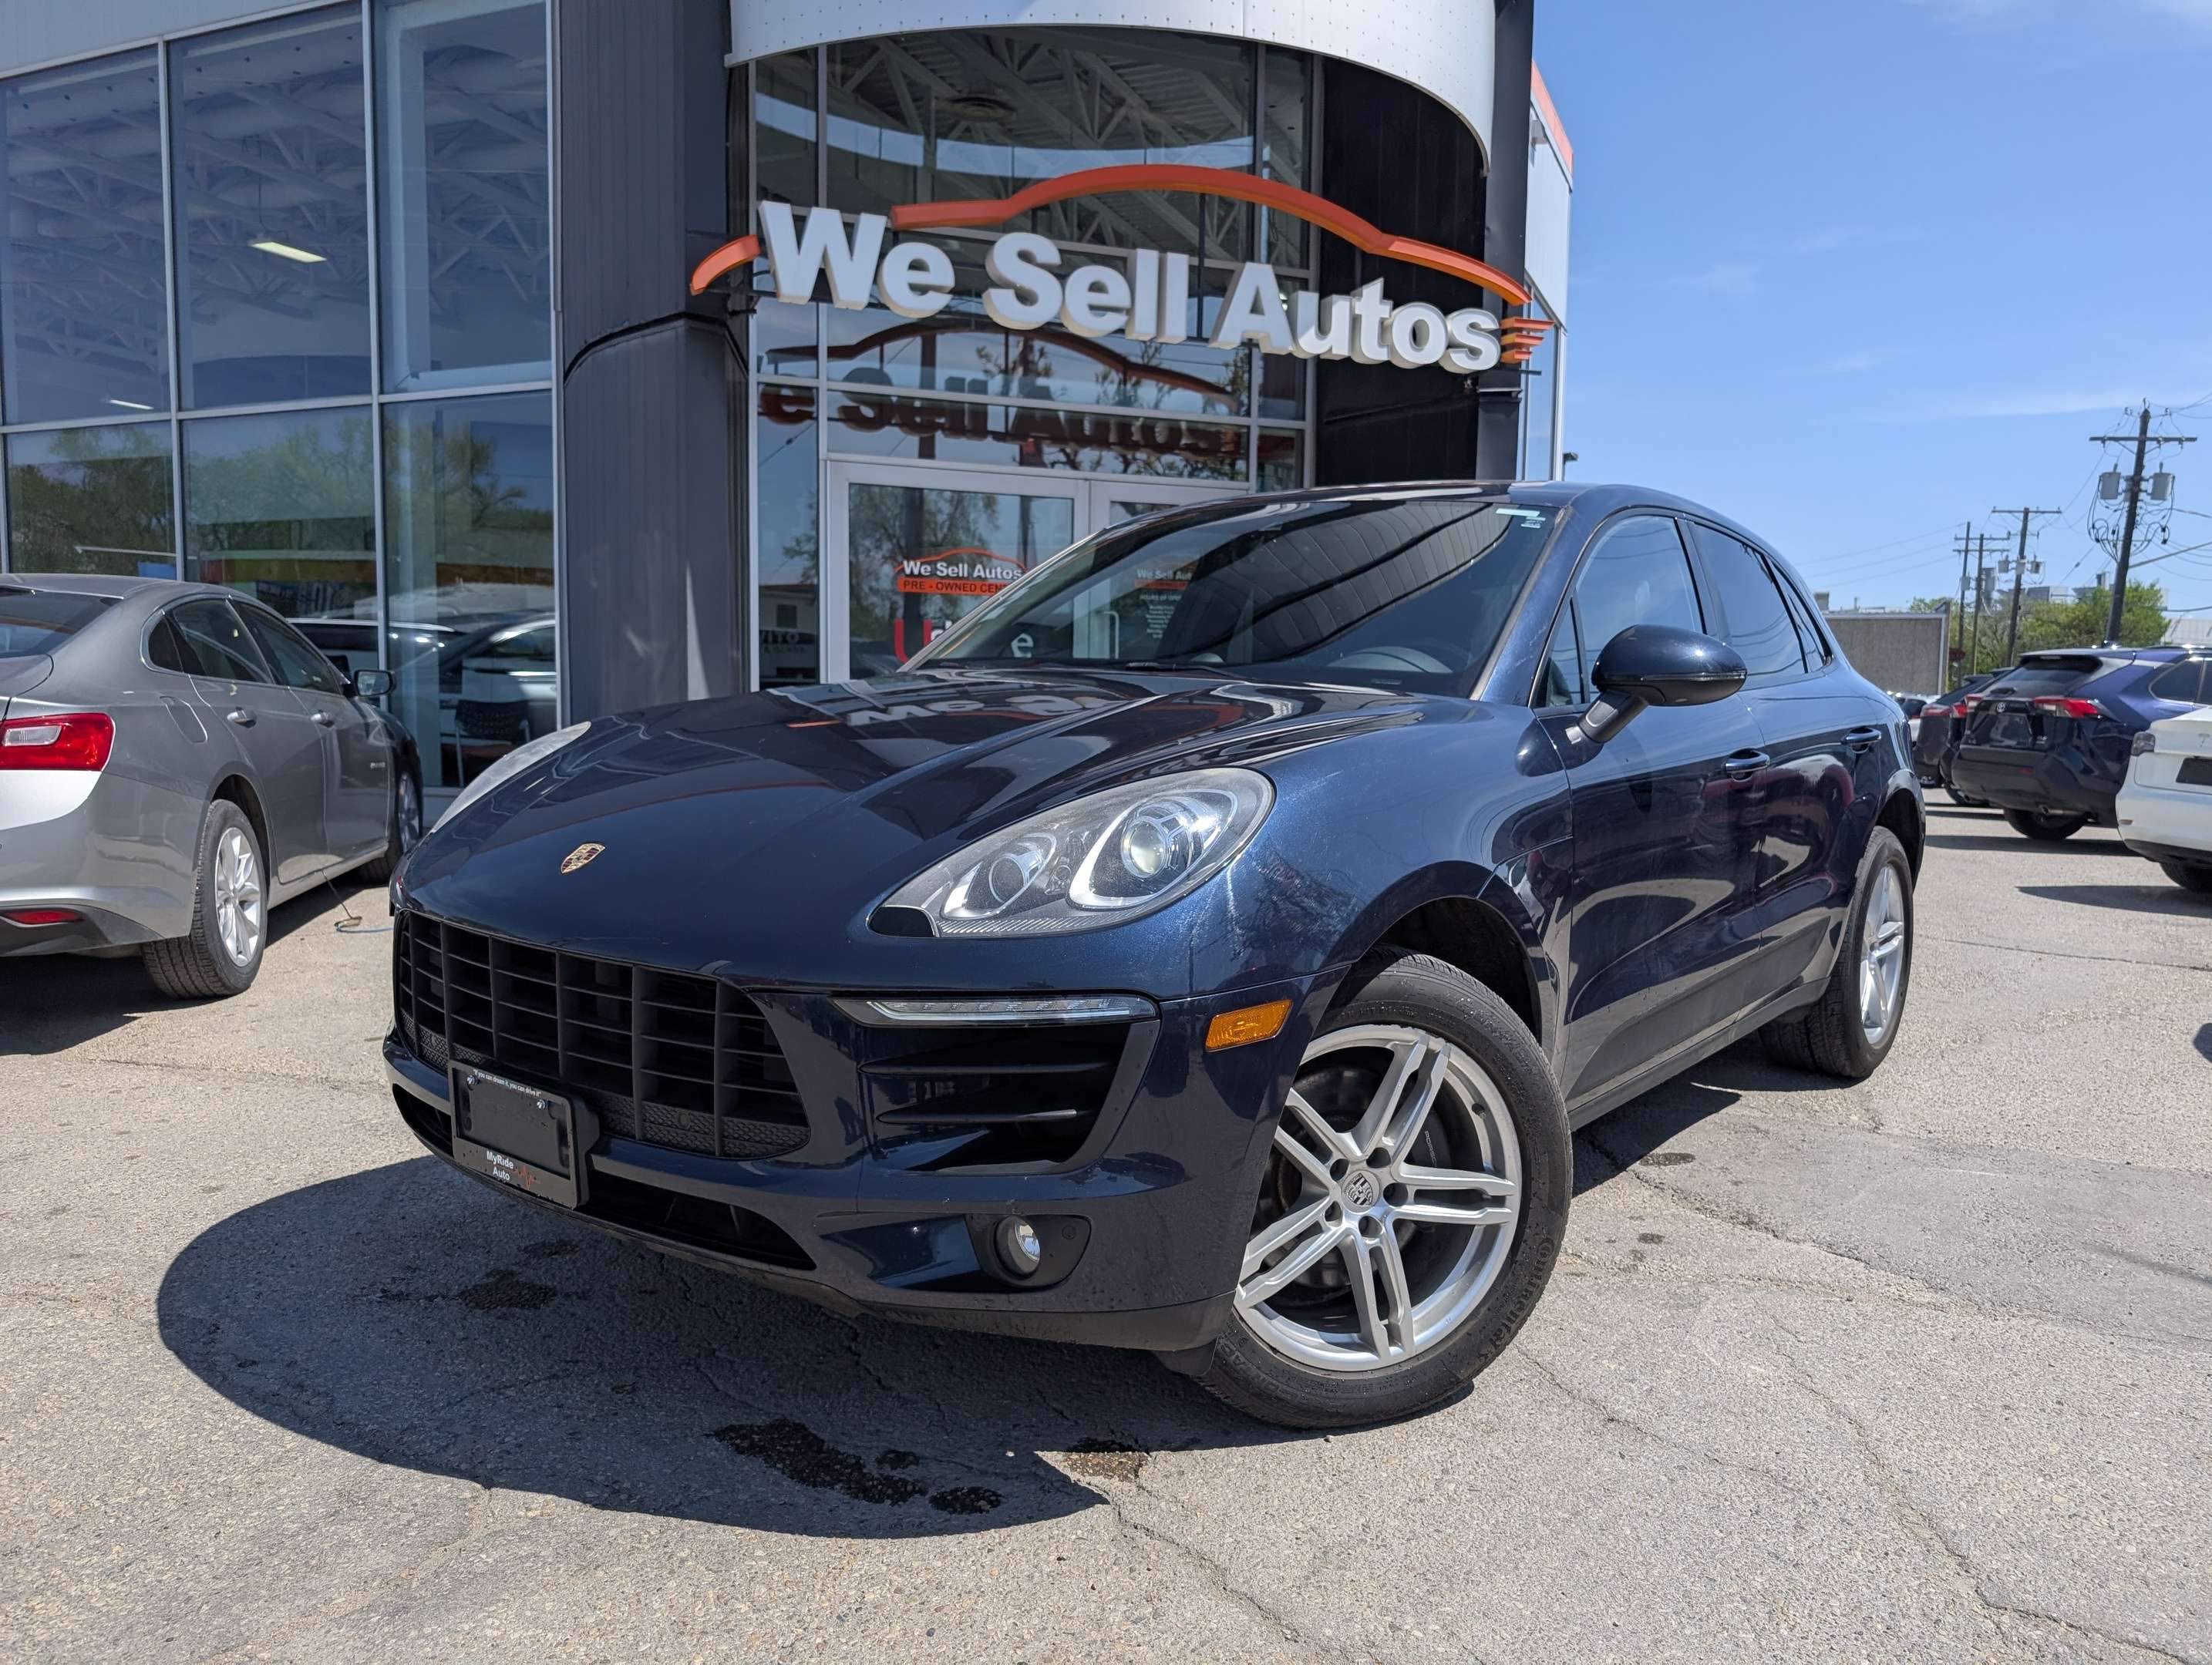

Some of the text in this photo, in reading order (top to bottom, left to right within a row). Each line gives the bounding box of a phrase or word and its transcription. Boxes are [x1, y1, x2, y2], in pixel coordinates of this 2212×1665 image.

[759, 200, 1501, 373] We Sell Autos
[904, 560, 1024, 580] We Sell Autos
[904, 580, 925, 590] PRE
[935, 581, 976, 593] OWNED
[1424, 1130, 1437, 1168] PORSC
[487, 1150, 514, 1169] MyRide
[493, 1166, 510, 1181] Auto
